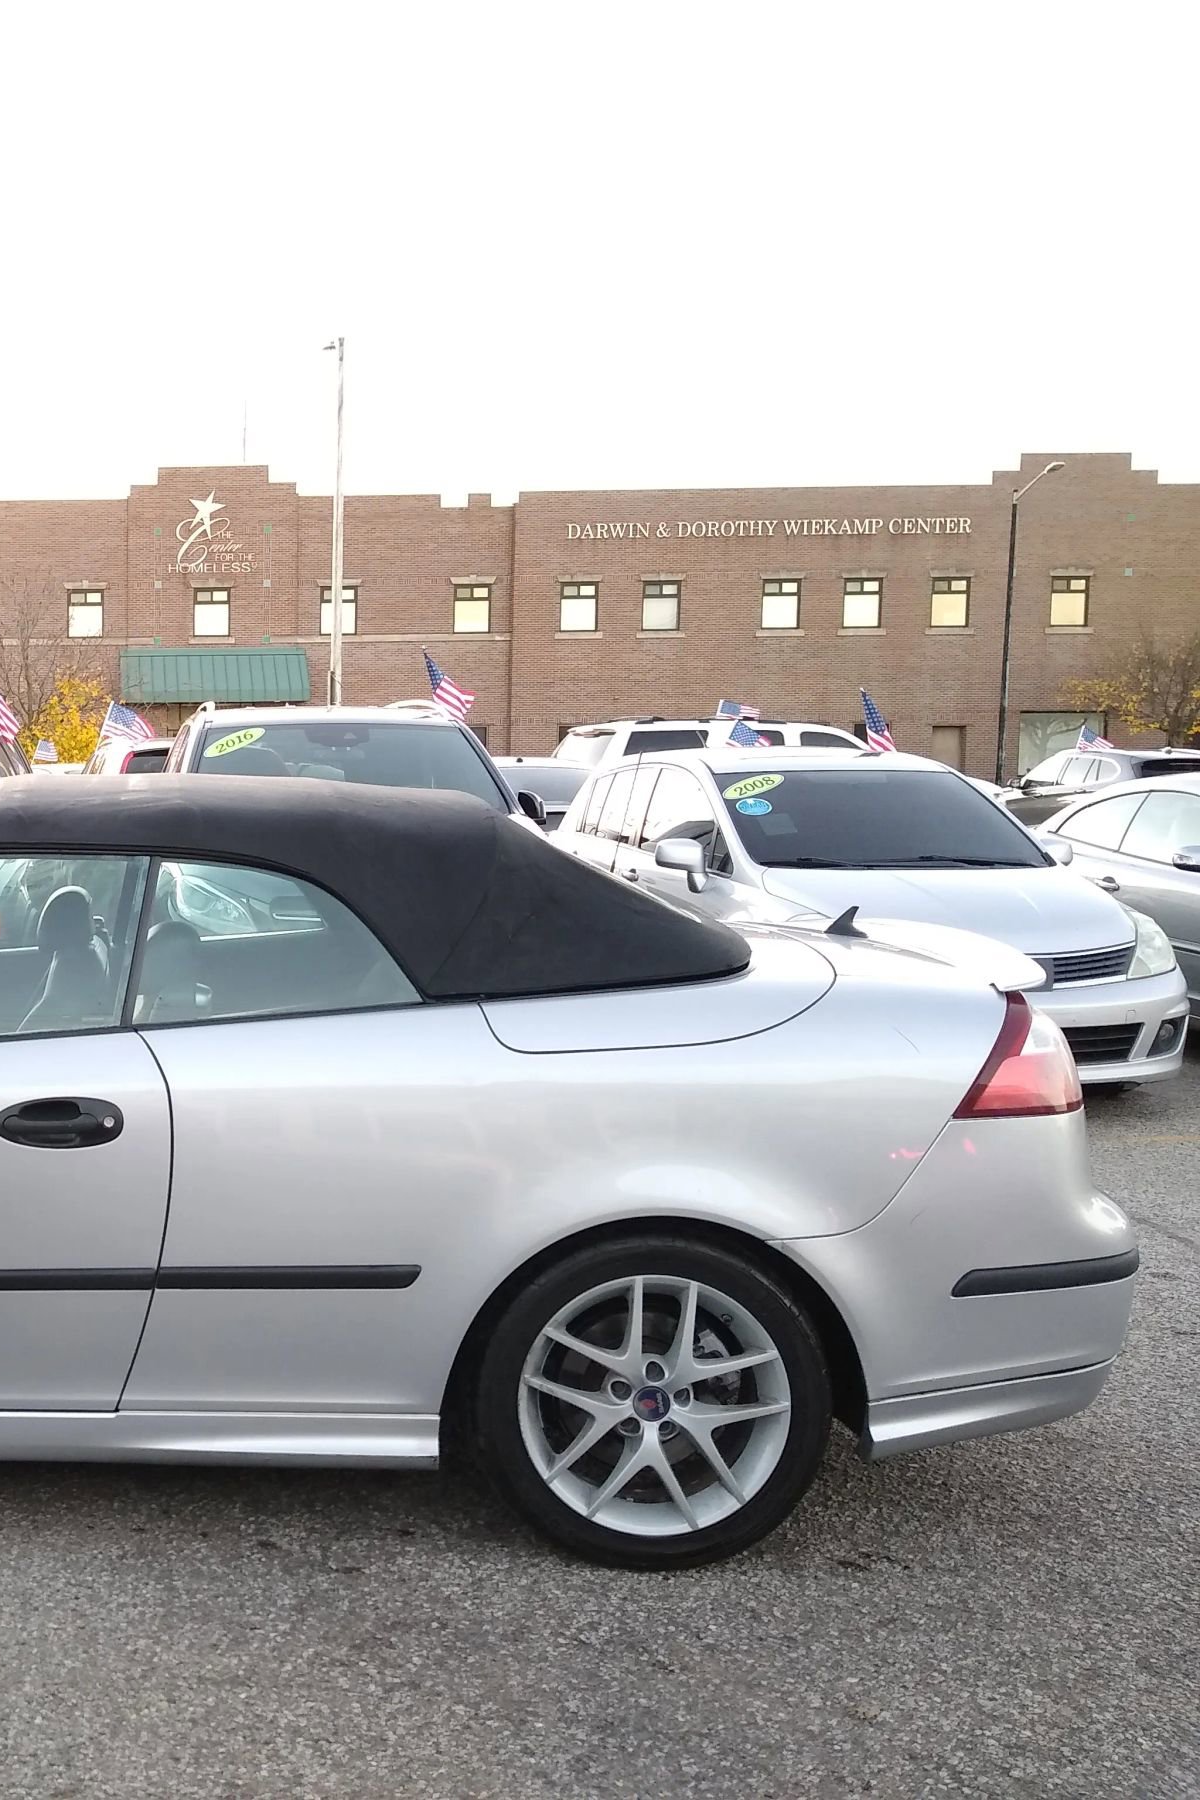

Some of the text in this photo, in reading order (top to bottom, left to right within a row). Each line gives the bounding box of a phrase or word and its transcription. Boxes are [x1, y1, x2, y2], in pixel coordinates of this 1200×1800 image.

[567, 517, 972, 539] DARWIN & DOROTHY WIEKAMP CENTER
[215, 552, 255, 562] FOR THE
[168, 562, 251, 573] HOMELESS
[215, 731, 254, 753] 2016
[734, 776, 775, 796] 2008
